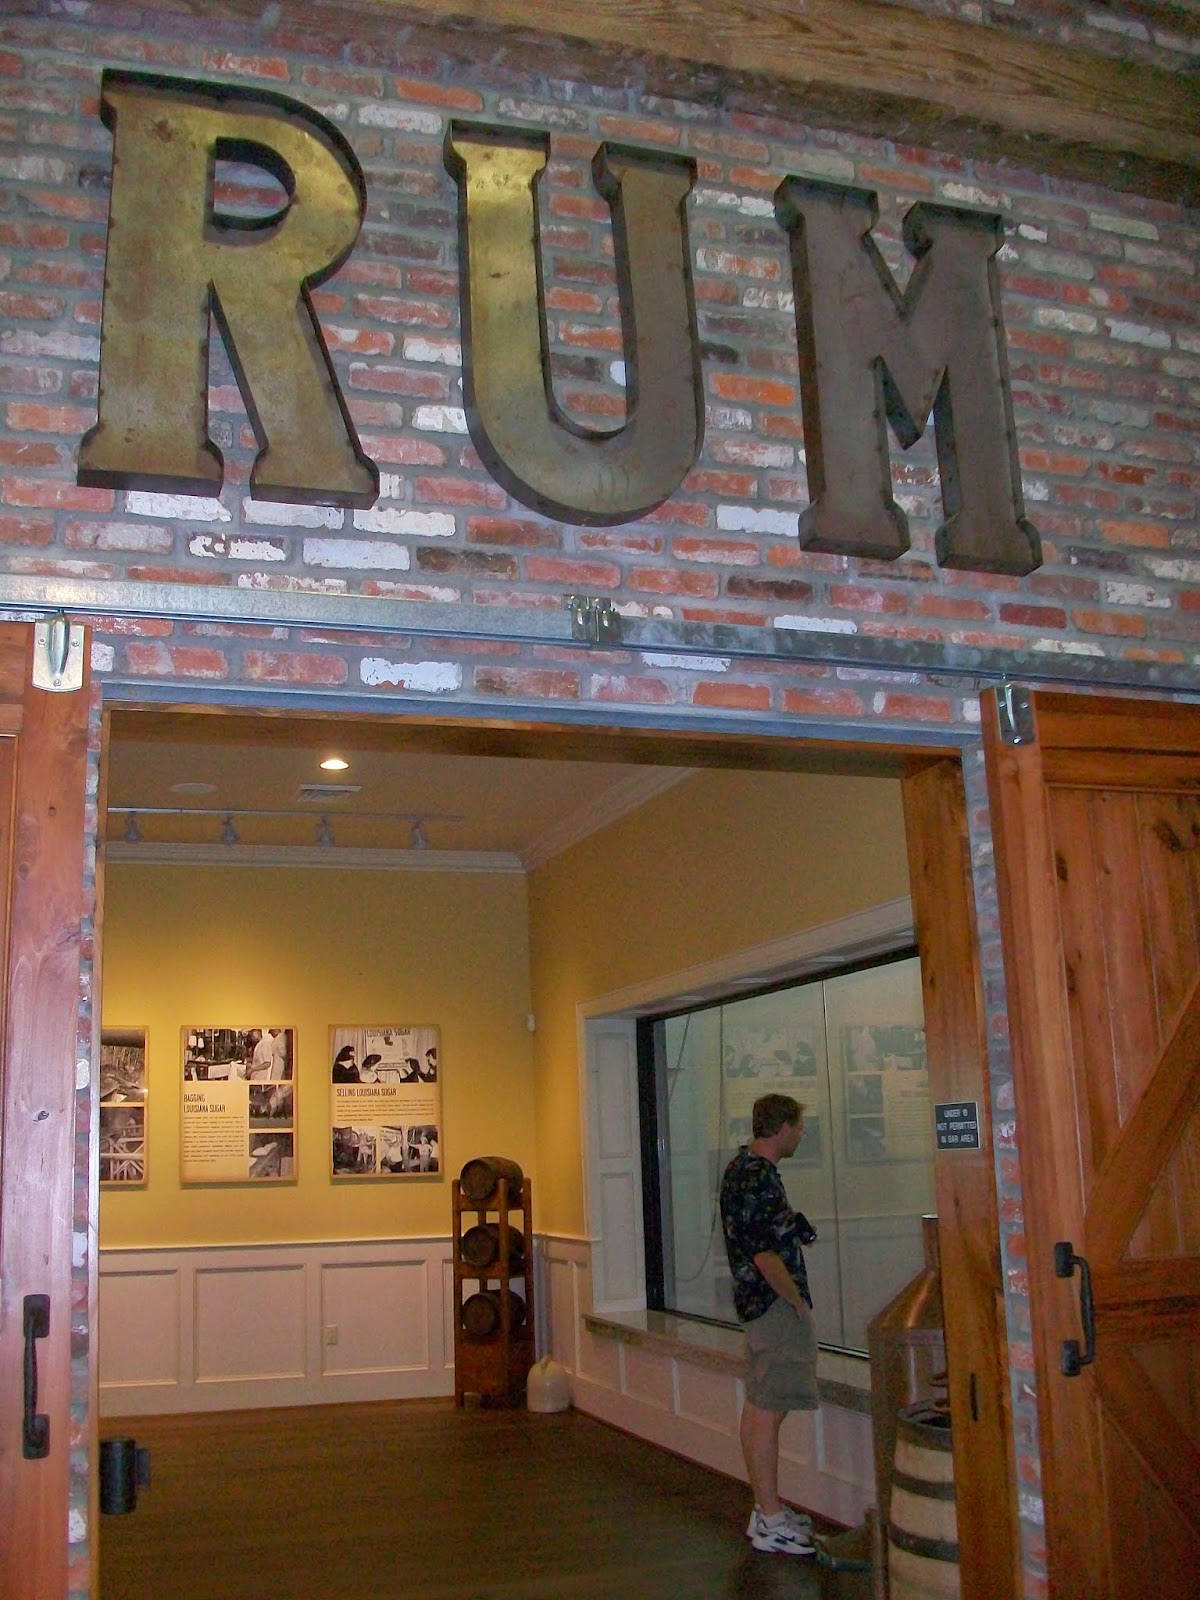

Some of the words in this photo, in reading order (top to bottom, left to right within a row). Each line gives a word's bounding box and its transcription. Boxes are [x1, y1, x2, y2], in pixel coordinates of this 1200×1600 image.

[77, 69, 1042, 577] RUM
[367, 1028, 393, 1037] LOUISIANA
[337, 1088, 356, 1097] SELLING
[357, 1088, 380, 1097] LOUISIANA
[381, 1088, 397, 1096] SUGAR
[183, 1094, 206, 1103] BAGGING
[183, 1104, 209, 1113] LOUISIANA
[209, 1104, 226, 1113] SUGAR
[944, 1109, 960, 1118] UNDER
[937, 1122, 947, 1131] NOT
[949, 1121, 977, 1131] PERMITTED
[940, 1135, 947, 1144] IN
[947, 1135, 958, 1144] BAR
[960, 1134, 974, 1143] AREA
